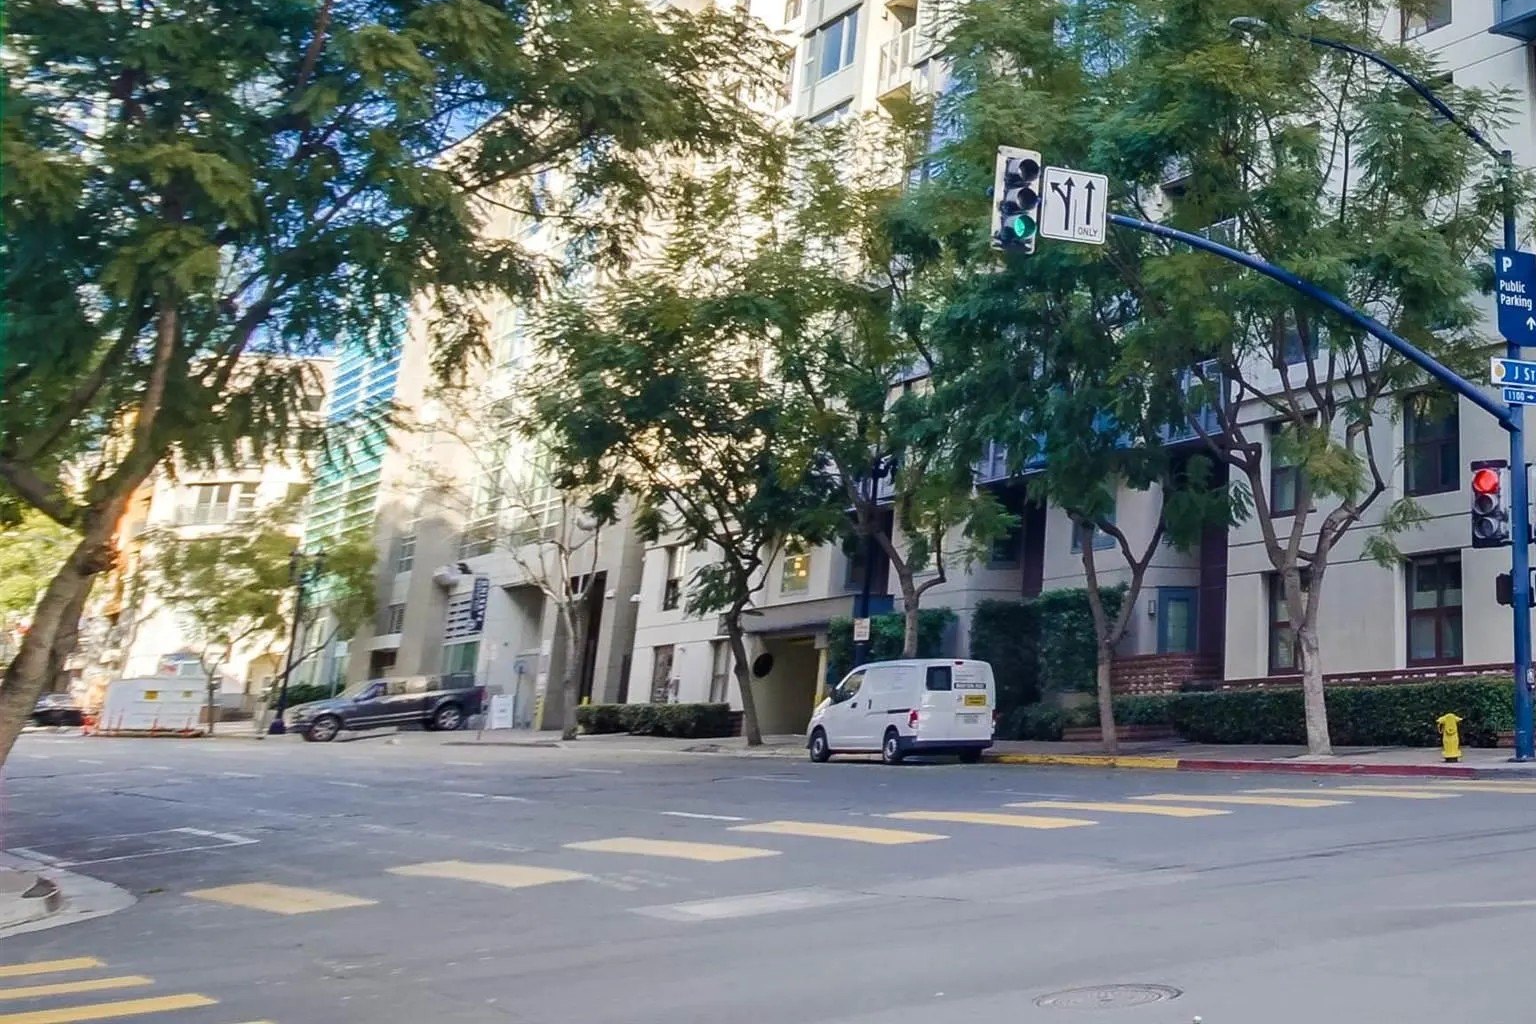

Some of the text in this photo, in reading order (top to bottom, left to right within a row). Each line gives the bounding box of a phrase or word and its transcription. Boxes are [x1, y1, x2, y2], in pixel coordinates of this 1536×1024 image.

[1077, 226, 1098, 237] ONLY
[1502, 256, 1512, 272] P
[1500, 279, 1526, 294] Public
[1500, 296, 1532, 311] Parking
[1513, 366, 1519, 380] J
[1508, 390, 1525, 401] 1100
